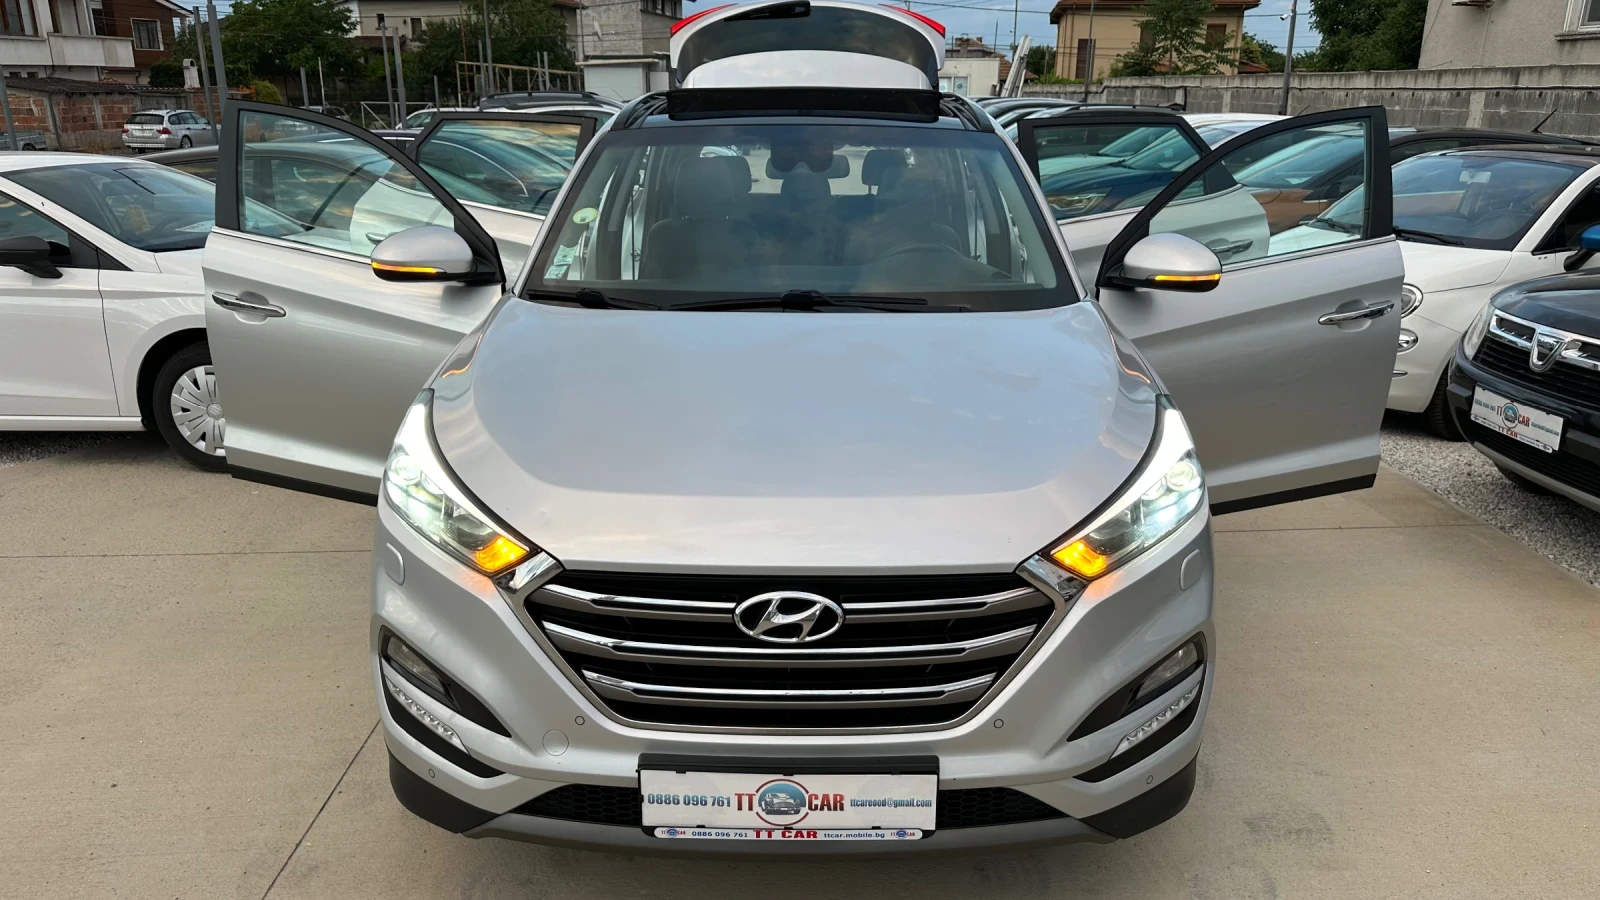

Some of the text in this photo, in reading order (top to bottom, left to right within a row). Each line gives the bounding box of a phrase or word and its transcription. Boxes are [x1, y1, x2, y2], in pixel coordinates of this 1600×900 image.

[1497, 405, 1503, 417] TT
[1518, 414, 1530, 427] CAR
[1506, 429, 1518, 438] CAR
[647, 793, 932, 811] 0886 096 761 TT CAR ttcareood@gmail.com
[753, 829, 775, 839] TT
[781, 829, 818, 839] CAR
[824, 831, 885, 839] ttcar.mobile.bg
